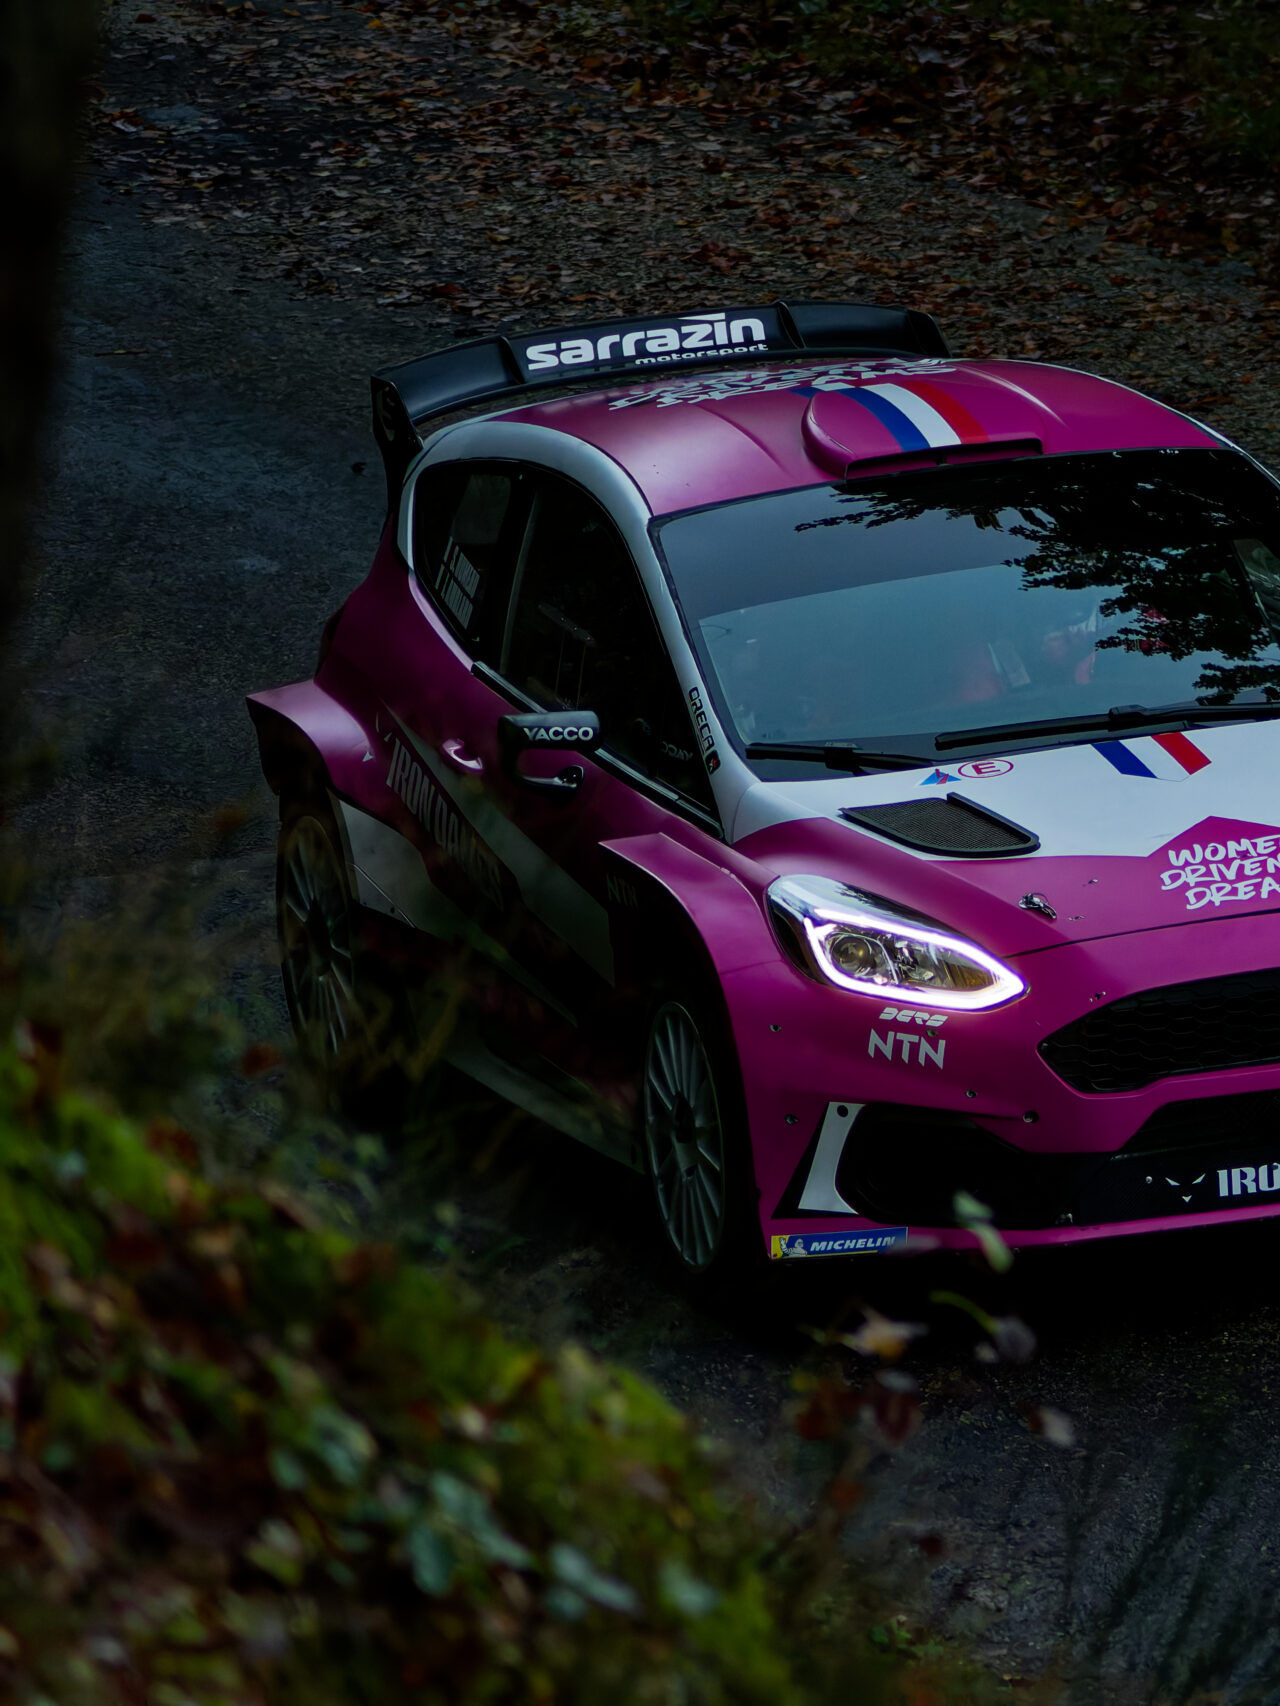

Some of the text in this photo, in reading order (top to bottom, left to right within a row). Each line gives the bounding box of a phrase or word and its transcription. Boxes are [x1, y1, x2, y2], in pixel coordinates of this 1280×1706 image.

[526, 312, 766, 370] sarrazin
[635, 343, 769, 365] motorsport
[523, 726, 594, 742] YACCO
[689, 687, 716, 752] ORECA
[386, 737, 437, 833] IRON
[867, 1027, 947, 1071] NTN
[809, 1236, 896, 1252] MICHELIN
